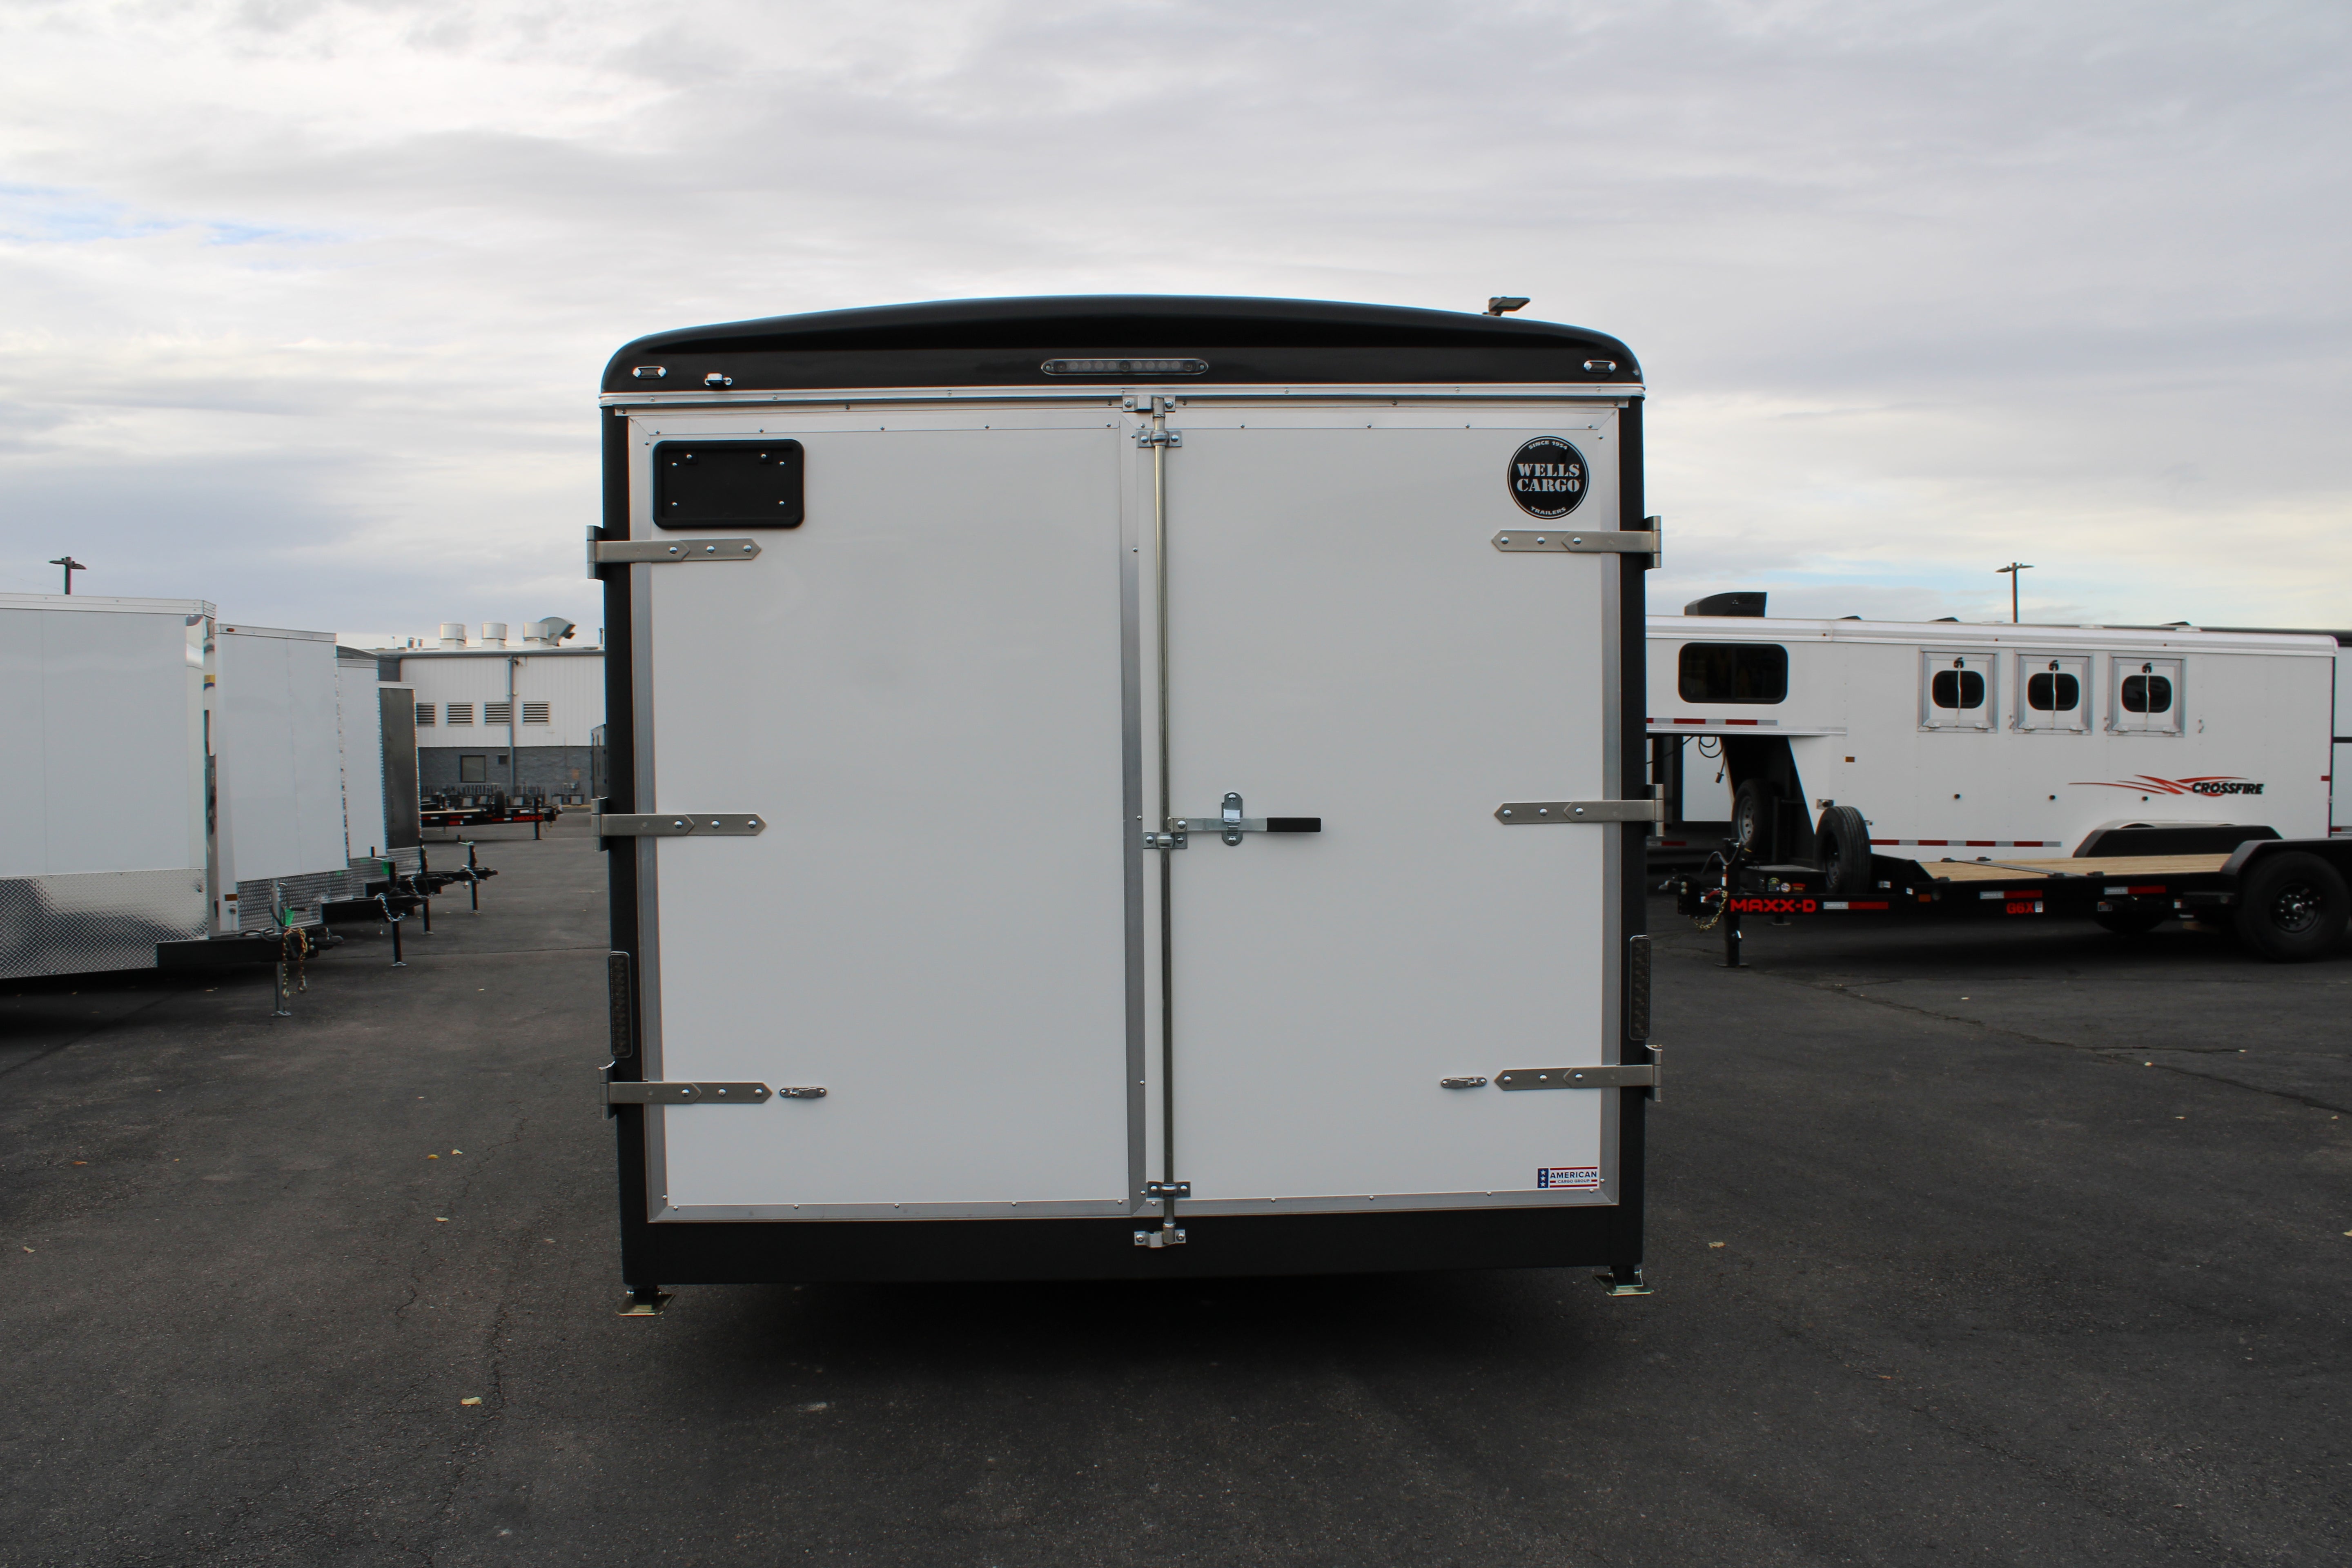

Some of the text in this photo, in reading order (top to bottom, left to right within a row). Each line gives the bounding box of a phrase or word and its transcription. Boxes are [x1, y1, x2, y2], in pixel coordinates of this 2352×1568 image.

[1528, 440, 1568, 450] SINCE 1954
[1517, 463, 1580, 477] WELLS
[1517, 479, 1580, 492] CARGO
[1531, 506, 1566, 515] TRAILERS
[2192, 782, 2265, 794] CROSSFIRE
[1730, 899, 1816, 912] MAXX-D
[2006, 902, 2034, 914] G6X
